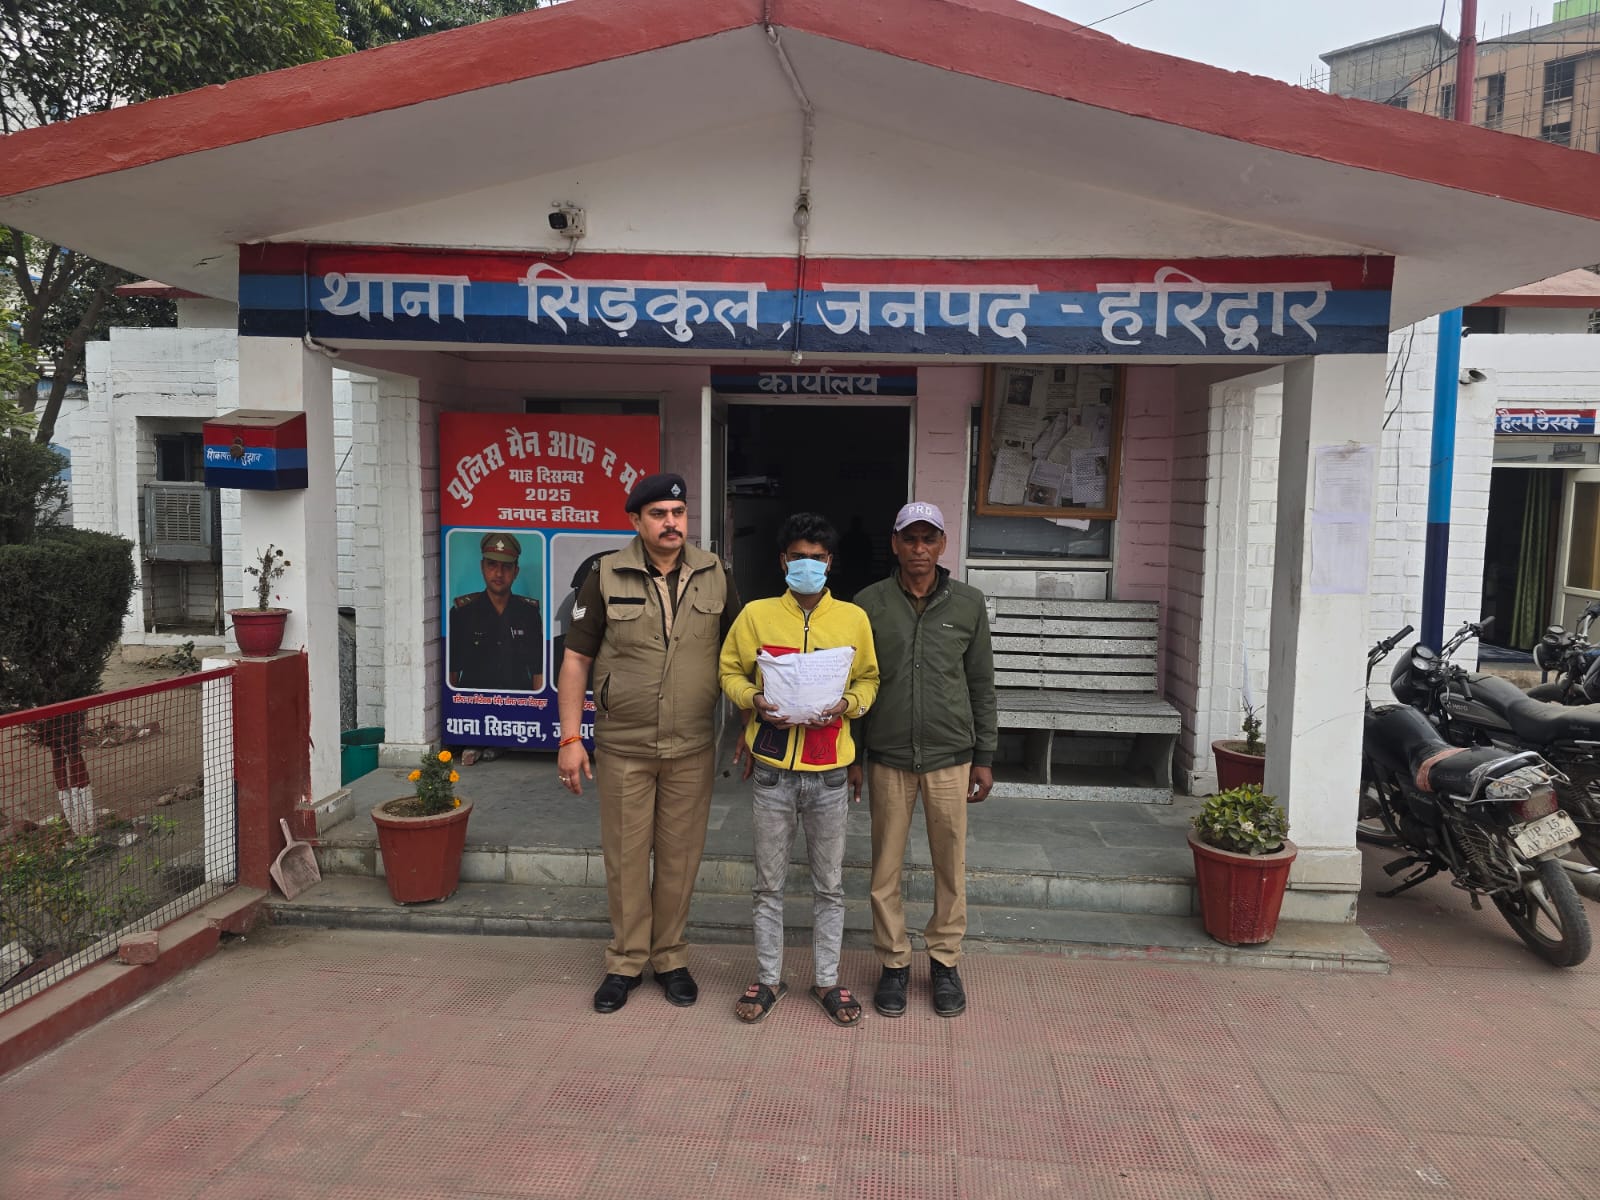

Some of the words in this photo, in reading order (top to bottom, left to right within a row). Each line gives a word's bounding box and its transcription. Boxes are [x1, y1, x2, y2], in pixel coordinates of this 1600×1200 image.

[320, 271, 471, 324] थाना
[816, 281, 1040, 349] जनपद
[1096, 266, 1333, 352] हरिद्वार
[757, 366, 880, 395] कार्यालय
[447, 442, 505, 508] पुलिस
[505, 427, 541, 460] मैन
[548, 430, 596, 464] आफ
[601, 448, 617, 478] द
[508, 468, 533, 484] माह
[537, 466, 584, 484] दिसम्बर
[525, 488, 571, 502] 2025
[498, 508, 548, 522] जनपद
[551, 506, 600, 523] हरिद्वार
[446, 717, 481, 736] थाना
[484, 715, 547, 743] सिडकुल,
[1546, 818, 1560, 831] 15
